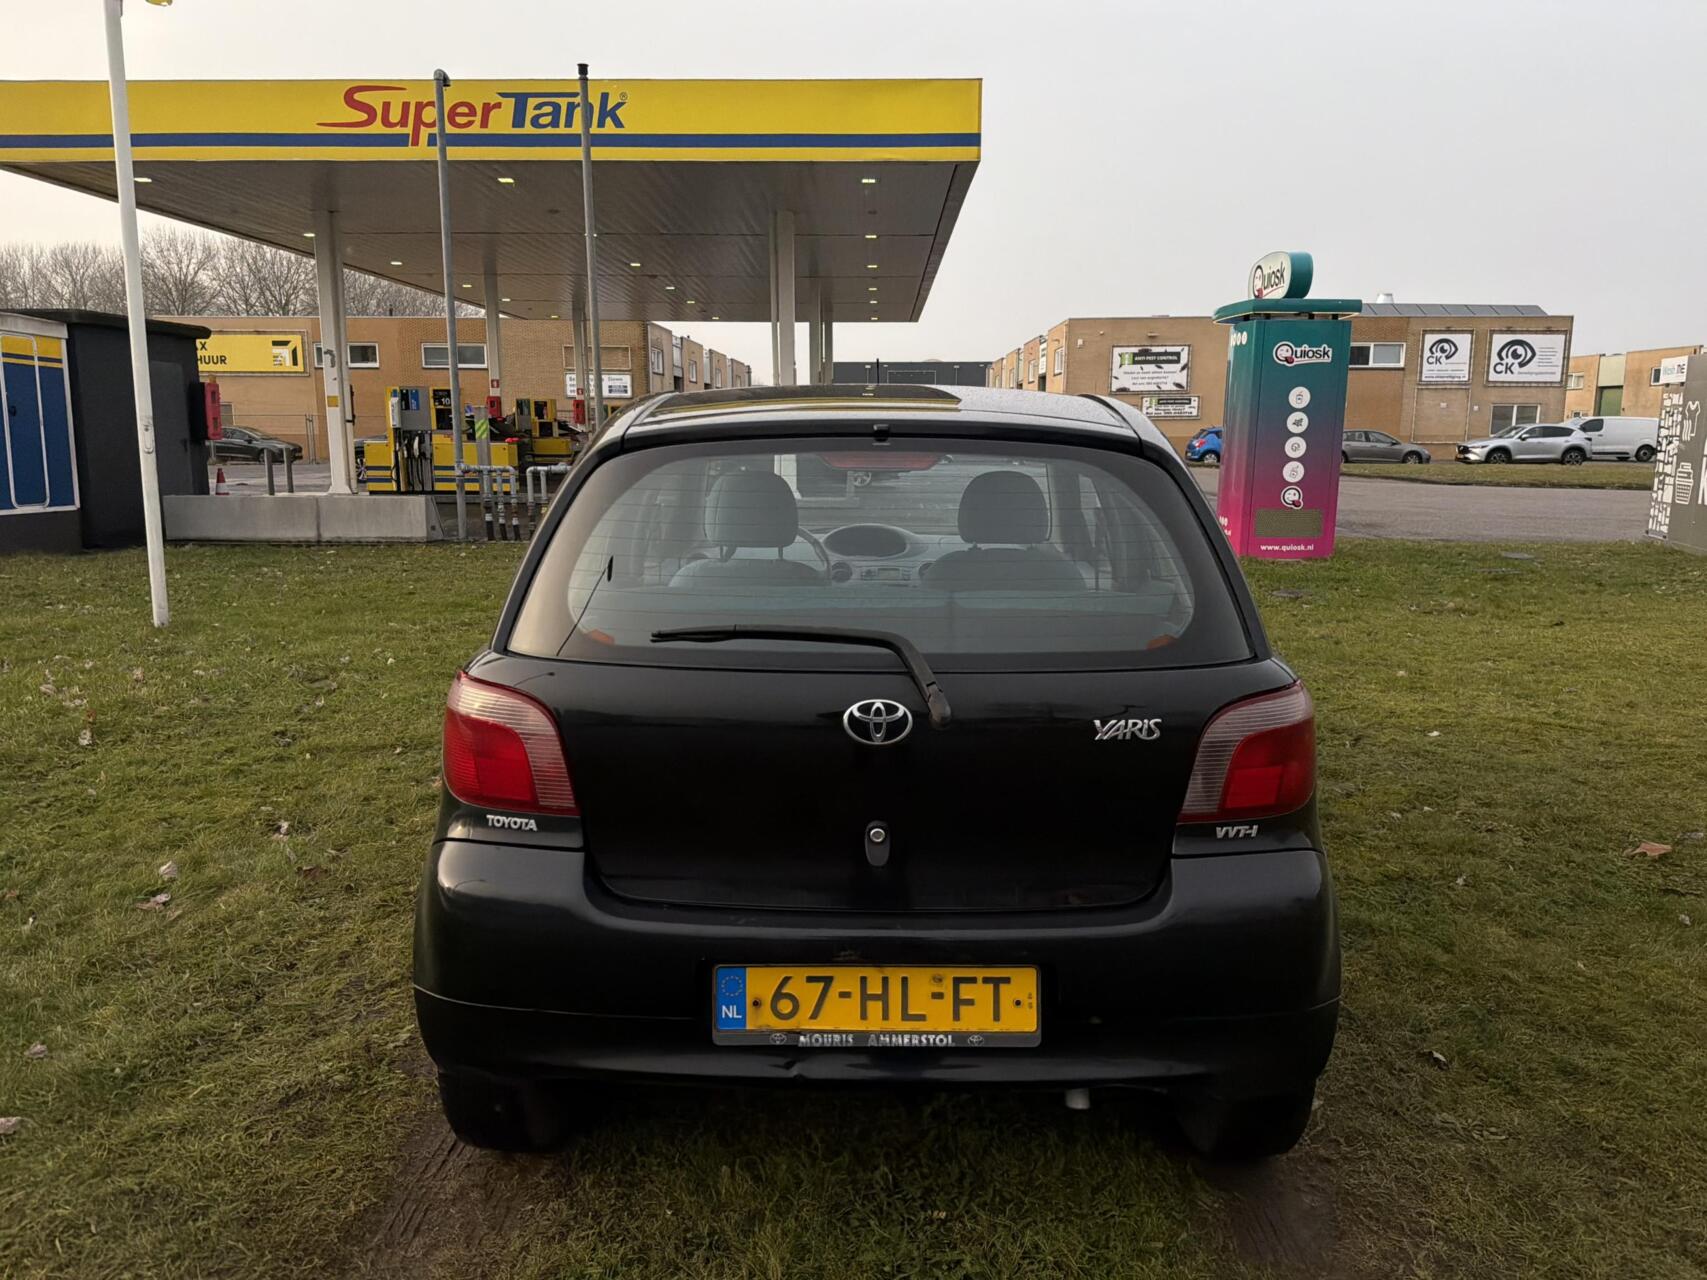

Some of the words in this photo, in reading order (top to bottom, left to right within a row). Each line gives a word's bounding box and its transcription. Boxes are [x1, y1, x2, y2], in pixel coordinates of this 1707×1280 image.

[1253, 261, 1285, 298] Quiosk
[1275, 343, 1331, 363] Quiosk
[1426, 355, 1443, 365] CK
[1493, 362, 1515, 375] CK
[1260, 544, 1314, 552] www.quiosk.nl
[486, 814, 538, 832] TOYOTA
[769, 975, 1012, 1022] 67-HL-FT
[721, 1005, 742, 1019] NL
[798, 1034, 853, 1047] MOURIS
[868, 1034, 956, 1047] AMMERSTOL
